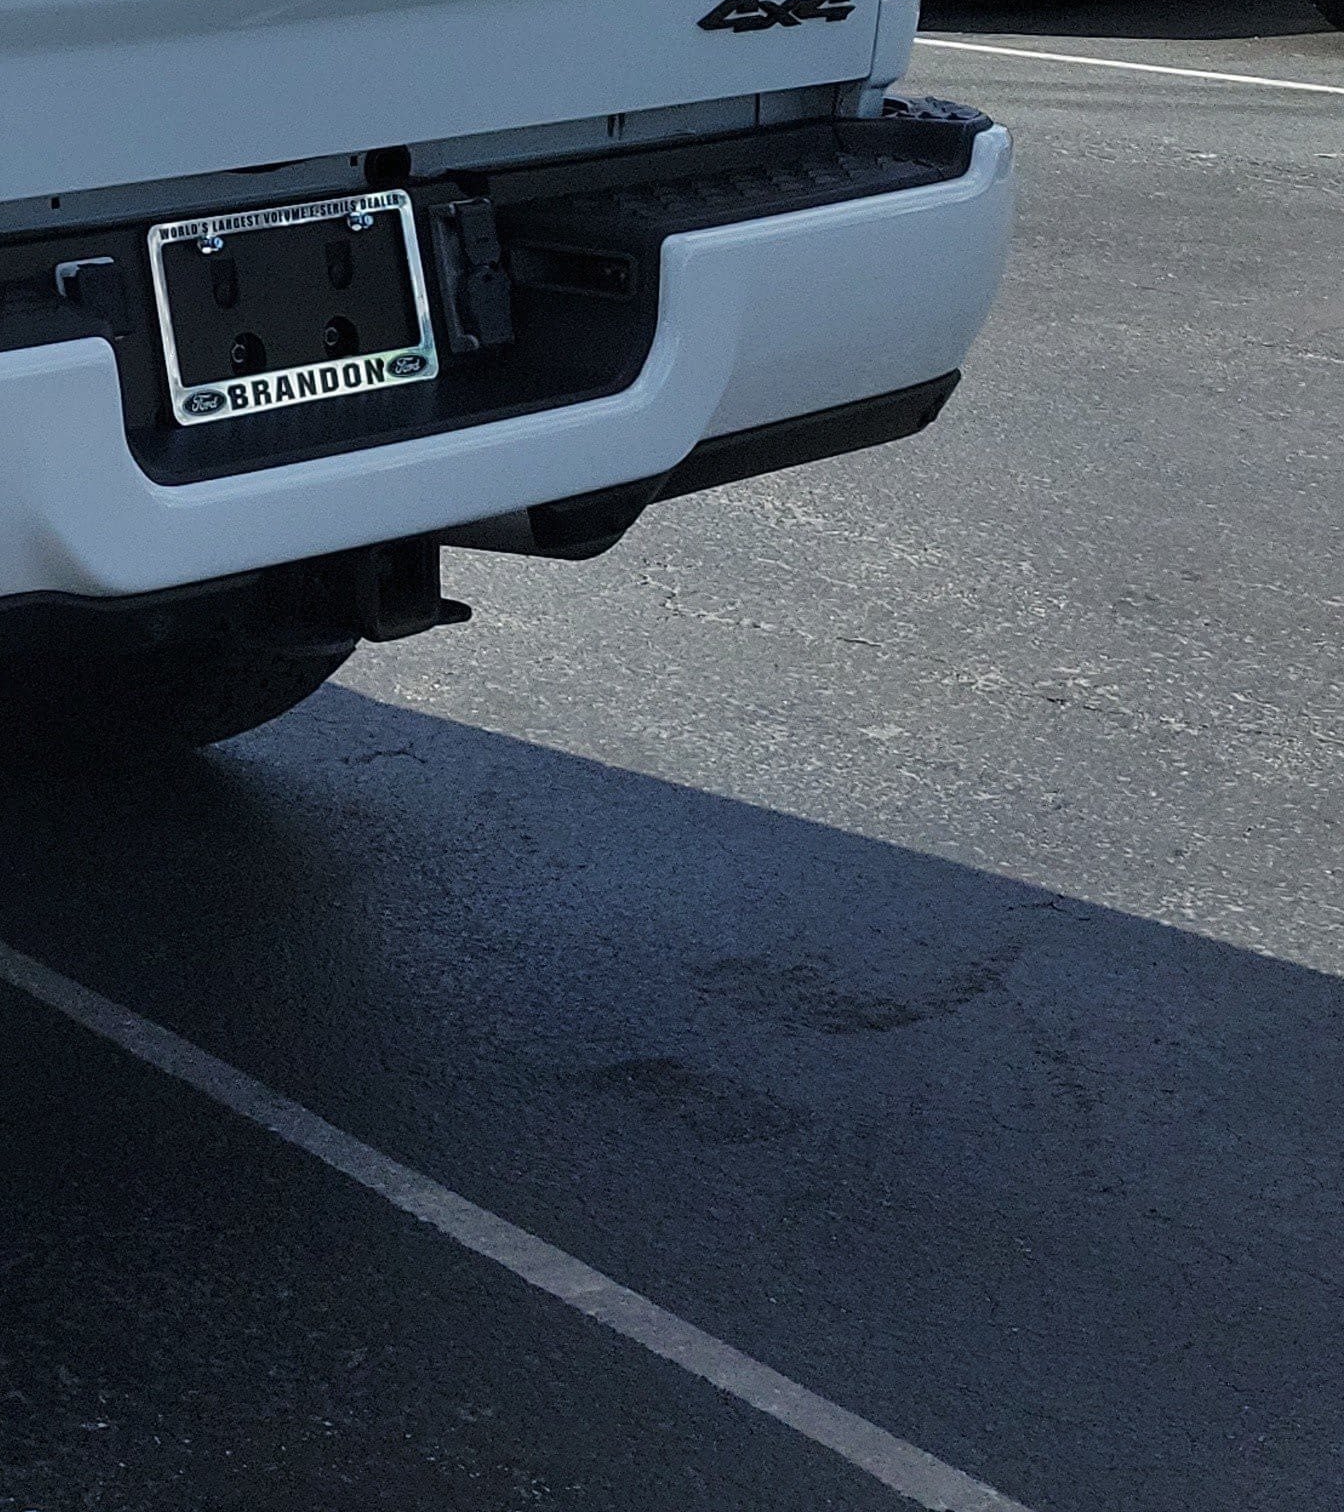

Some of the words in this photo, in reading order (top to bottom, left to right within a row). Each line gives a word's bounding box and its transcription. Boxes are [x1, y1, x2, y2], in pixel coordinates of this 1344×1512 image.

[159, 221, 209, 241] WORLD'S
[212, 214, 260, 233] LARGEST
[263, 206, 306, 224] VOLUME
[360, 193, 400, 210] DEALER
[191, 392, 218, 413] Ford
[226, 357, 387, 410] BRANDON
[394, 356, 421, 375] Ford
